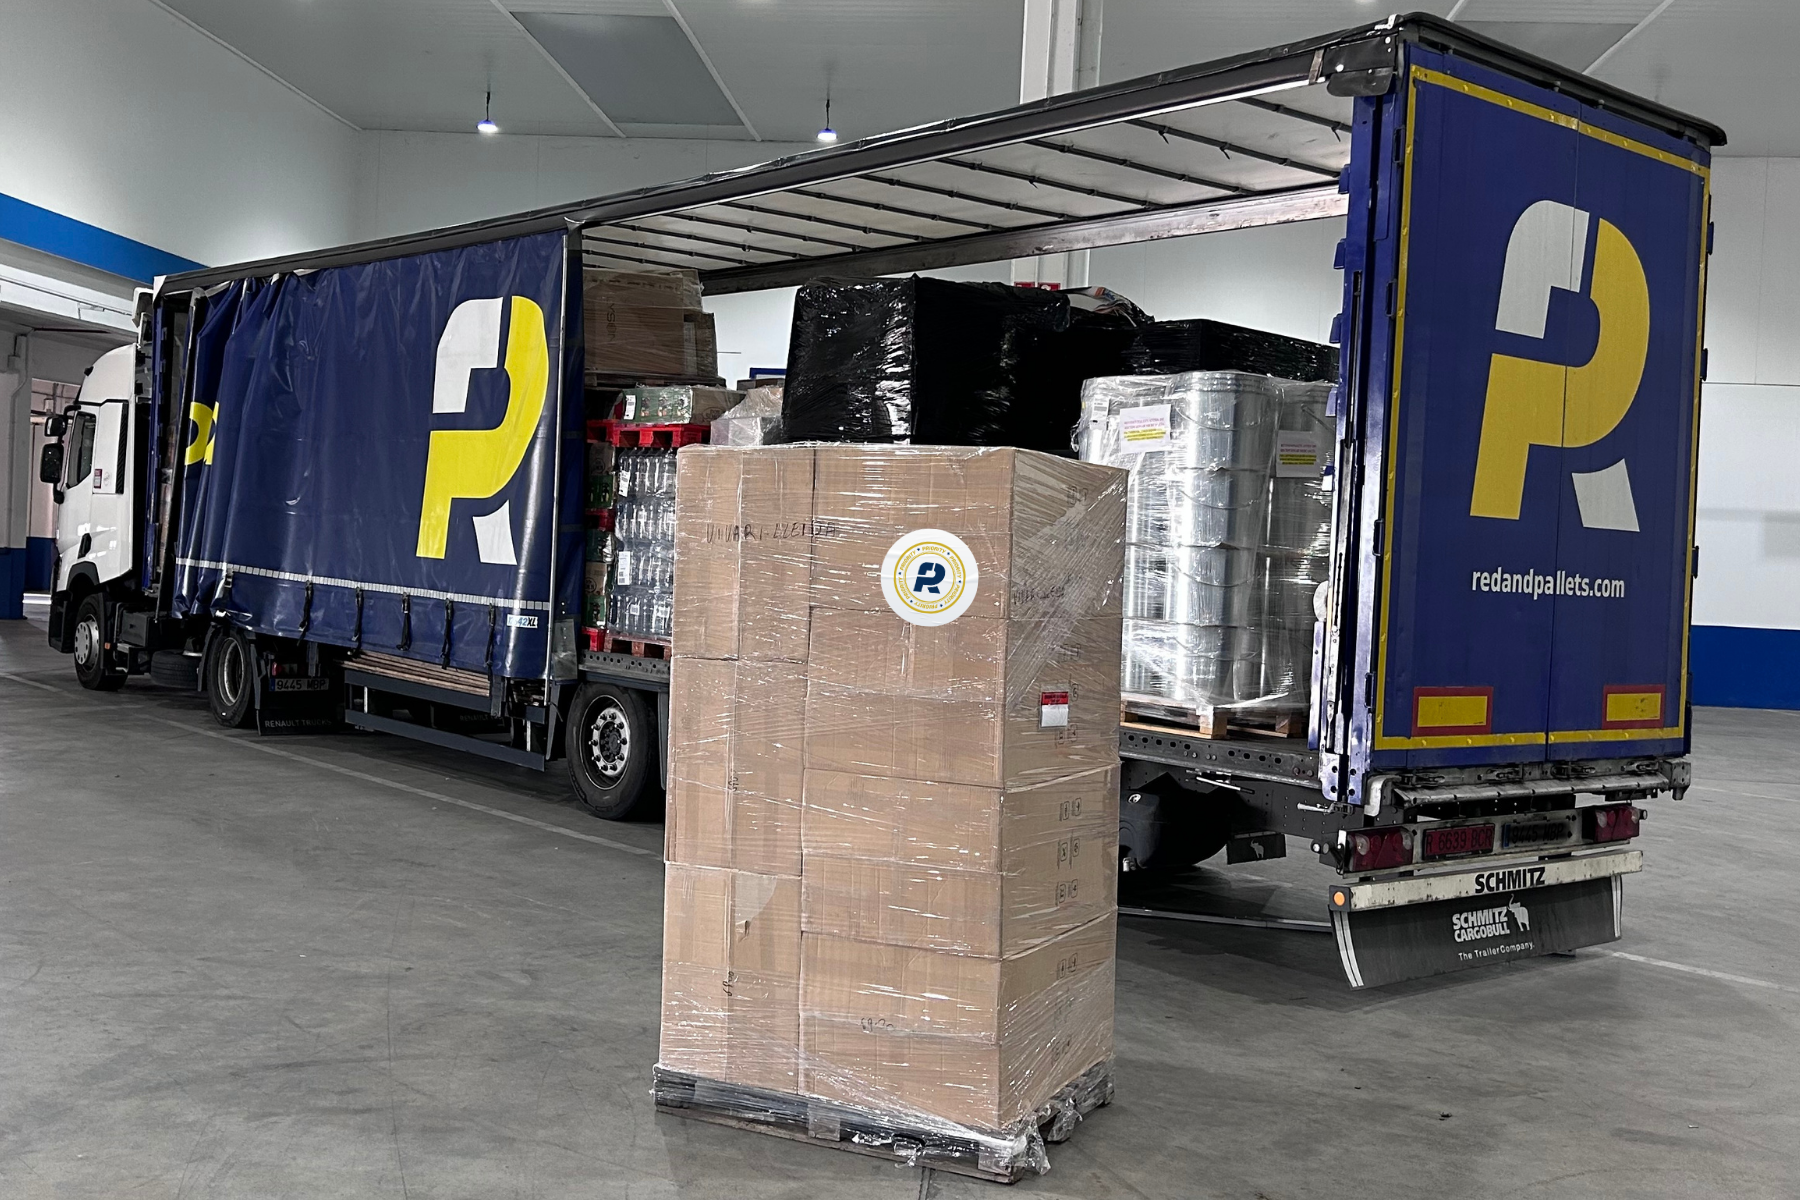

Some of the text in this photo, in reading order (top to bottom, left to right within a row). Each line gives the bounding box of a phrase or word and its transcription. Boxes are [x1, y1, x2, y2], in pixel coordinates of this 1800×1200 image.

[922, 546, 947, 554] PRIORITY
[1471, 566, 1625, 600] redandpallets.com
[277, 680, 302, 690] 9445
[264, 720, 300, 728] RENAULT
[1426, 829, 1493, 852] R 6639 BCR
[1512, 824, 1538, 844] 9445
[1475, 867, 1546, 894] SCHMITZ
[1452, 906, 1508, 930] SCHMITZ
[1454, 922, 1510, 943] CARGOBULL
[1458, 952, 1473, 961] The
